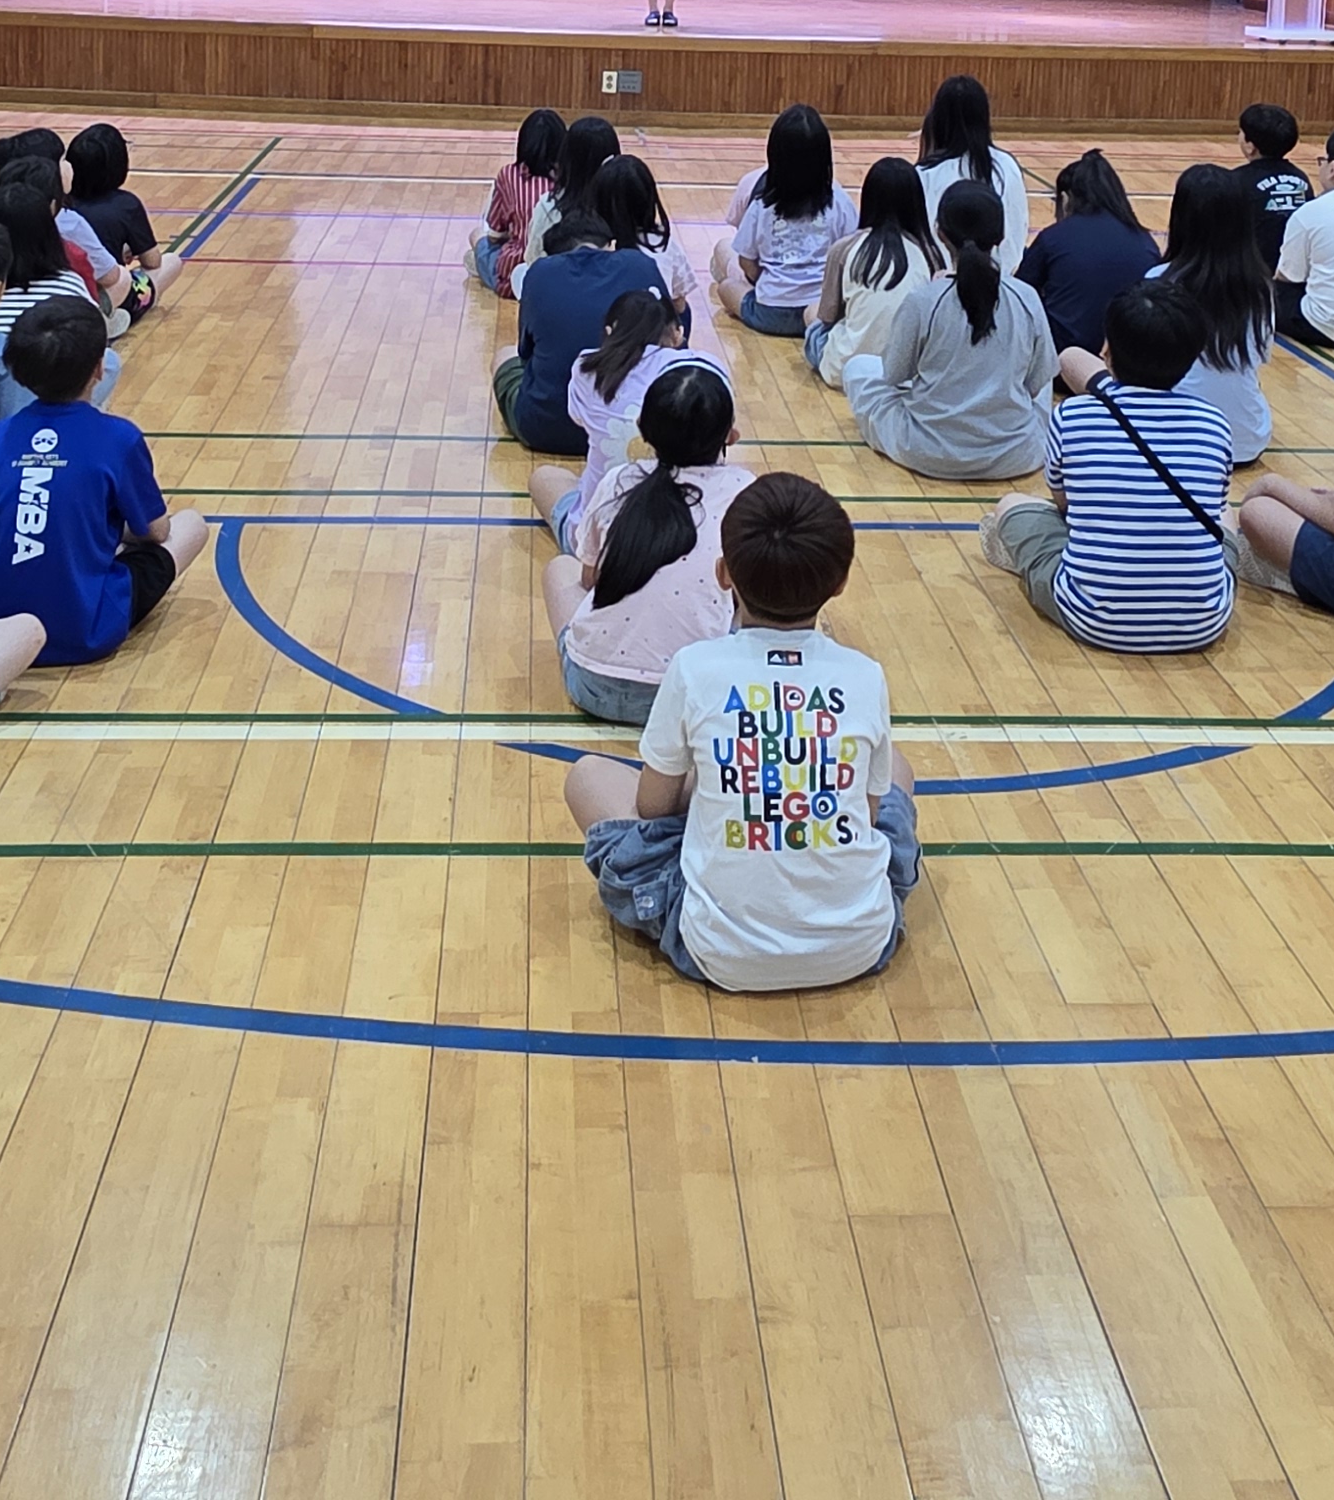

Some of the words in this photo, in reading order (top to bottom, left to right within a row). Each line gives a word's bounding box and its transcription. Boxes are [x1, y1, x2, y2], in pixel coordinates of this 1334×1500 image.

[11, 467, 54, 566] MBA
[723, 681, 845, 714] ADIDAS
[738, 710, 838, 739] BUILD
[713, 736, 858, 766] UNBUILD
[720, 763, 855, 795] REBUILD
[743, 791, 838, 822] LEGO
[725, 815, 853, 851] BRICKS
